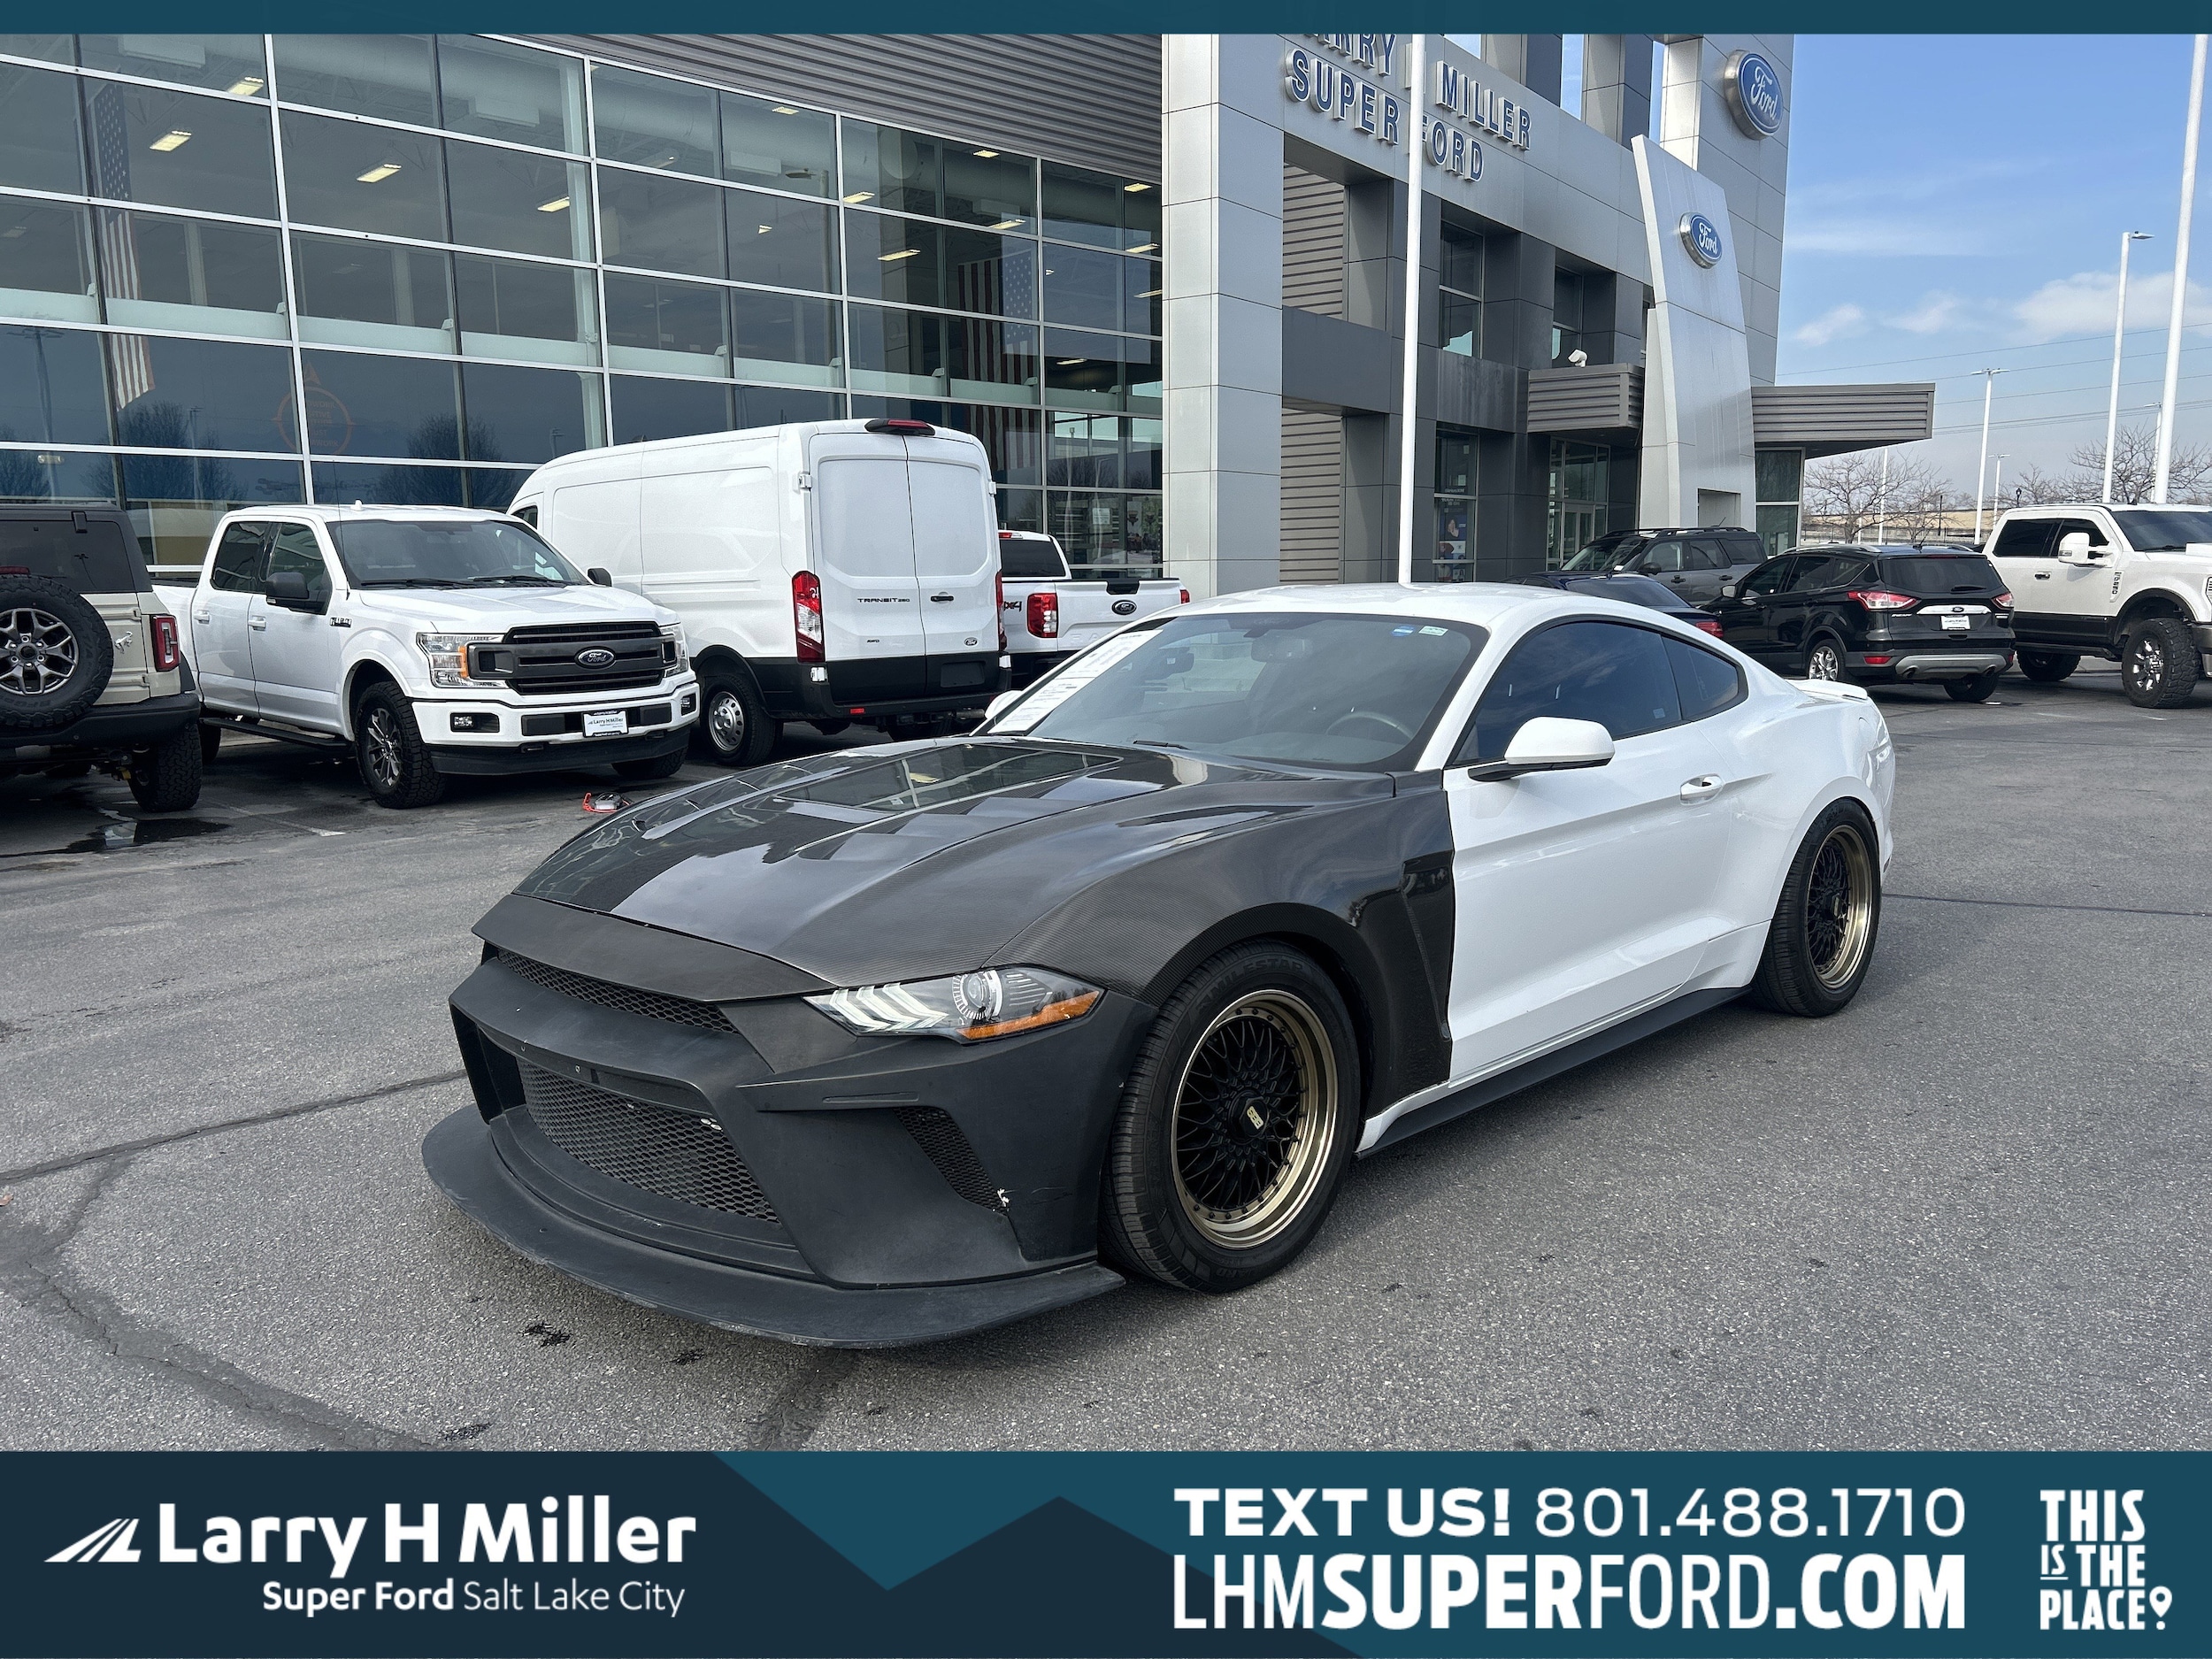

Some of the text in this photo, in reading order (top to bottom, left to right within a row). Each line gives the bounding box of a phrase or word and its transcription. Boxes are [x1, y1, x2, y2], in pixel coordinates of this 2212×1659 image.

[1285, 48, 1400, 145] SUPER
[1422, 114, 1484, 182] ORD
[1436, 60, 1532, 150] MILLER
[1750, 65, 1778, 120] Ford
[1699, 222, 1717, 255] Ford
